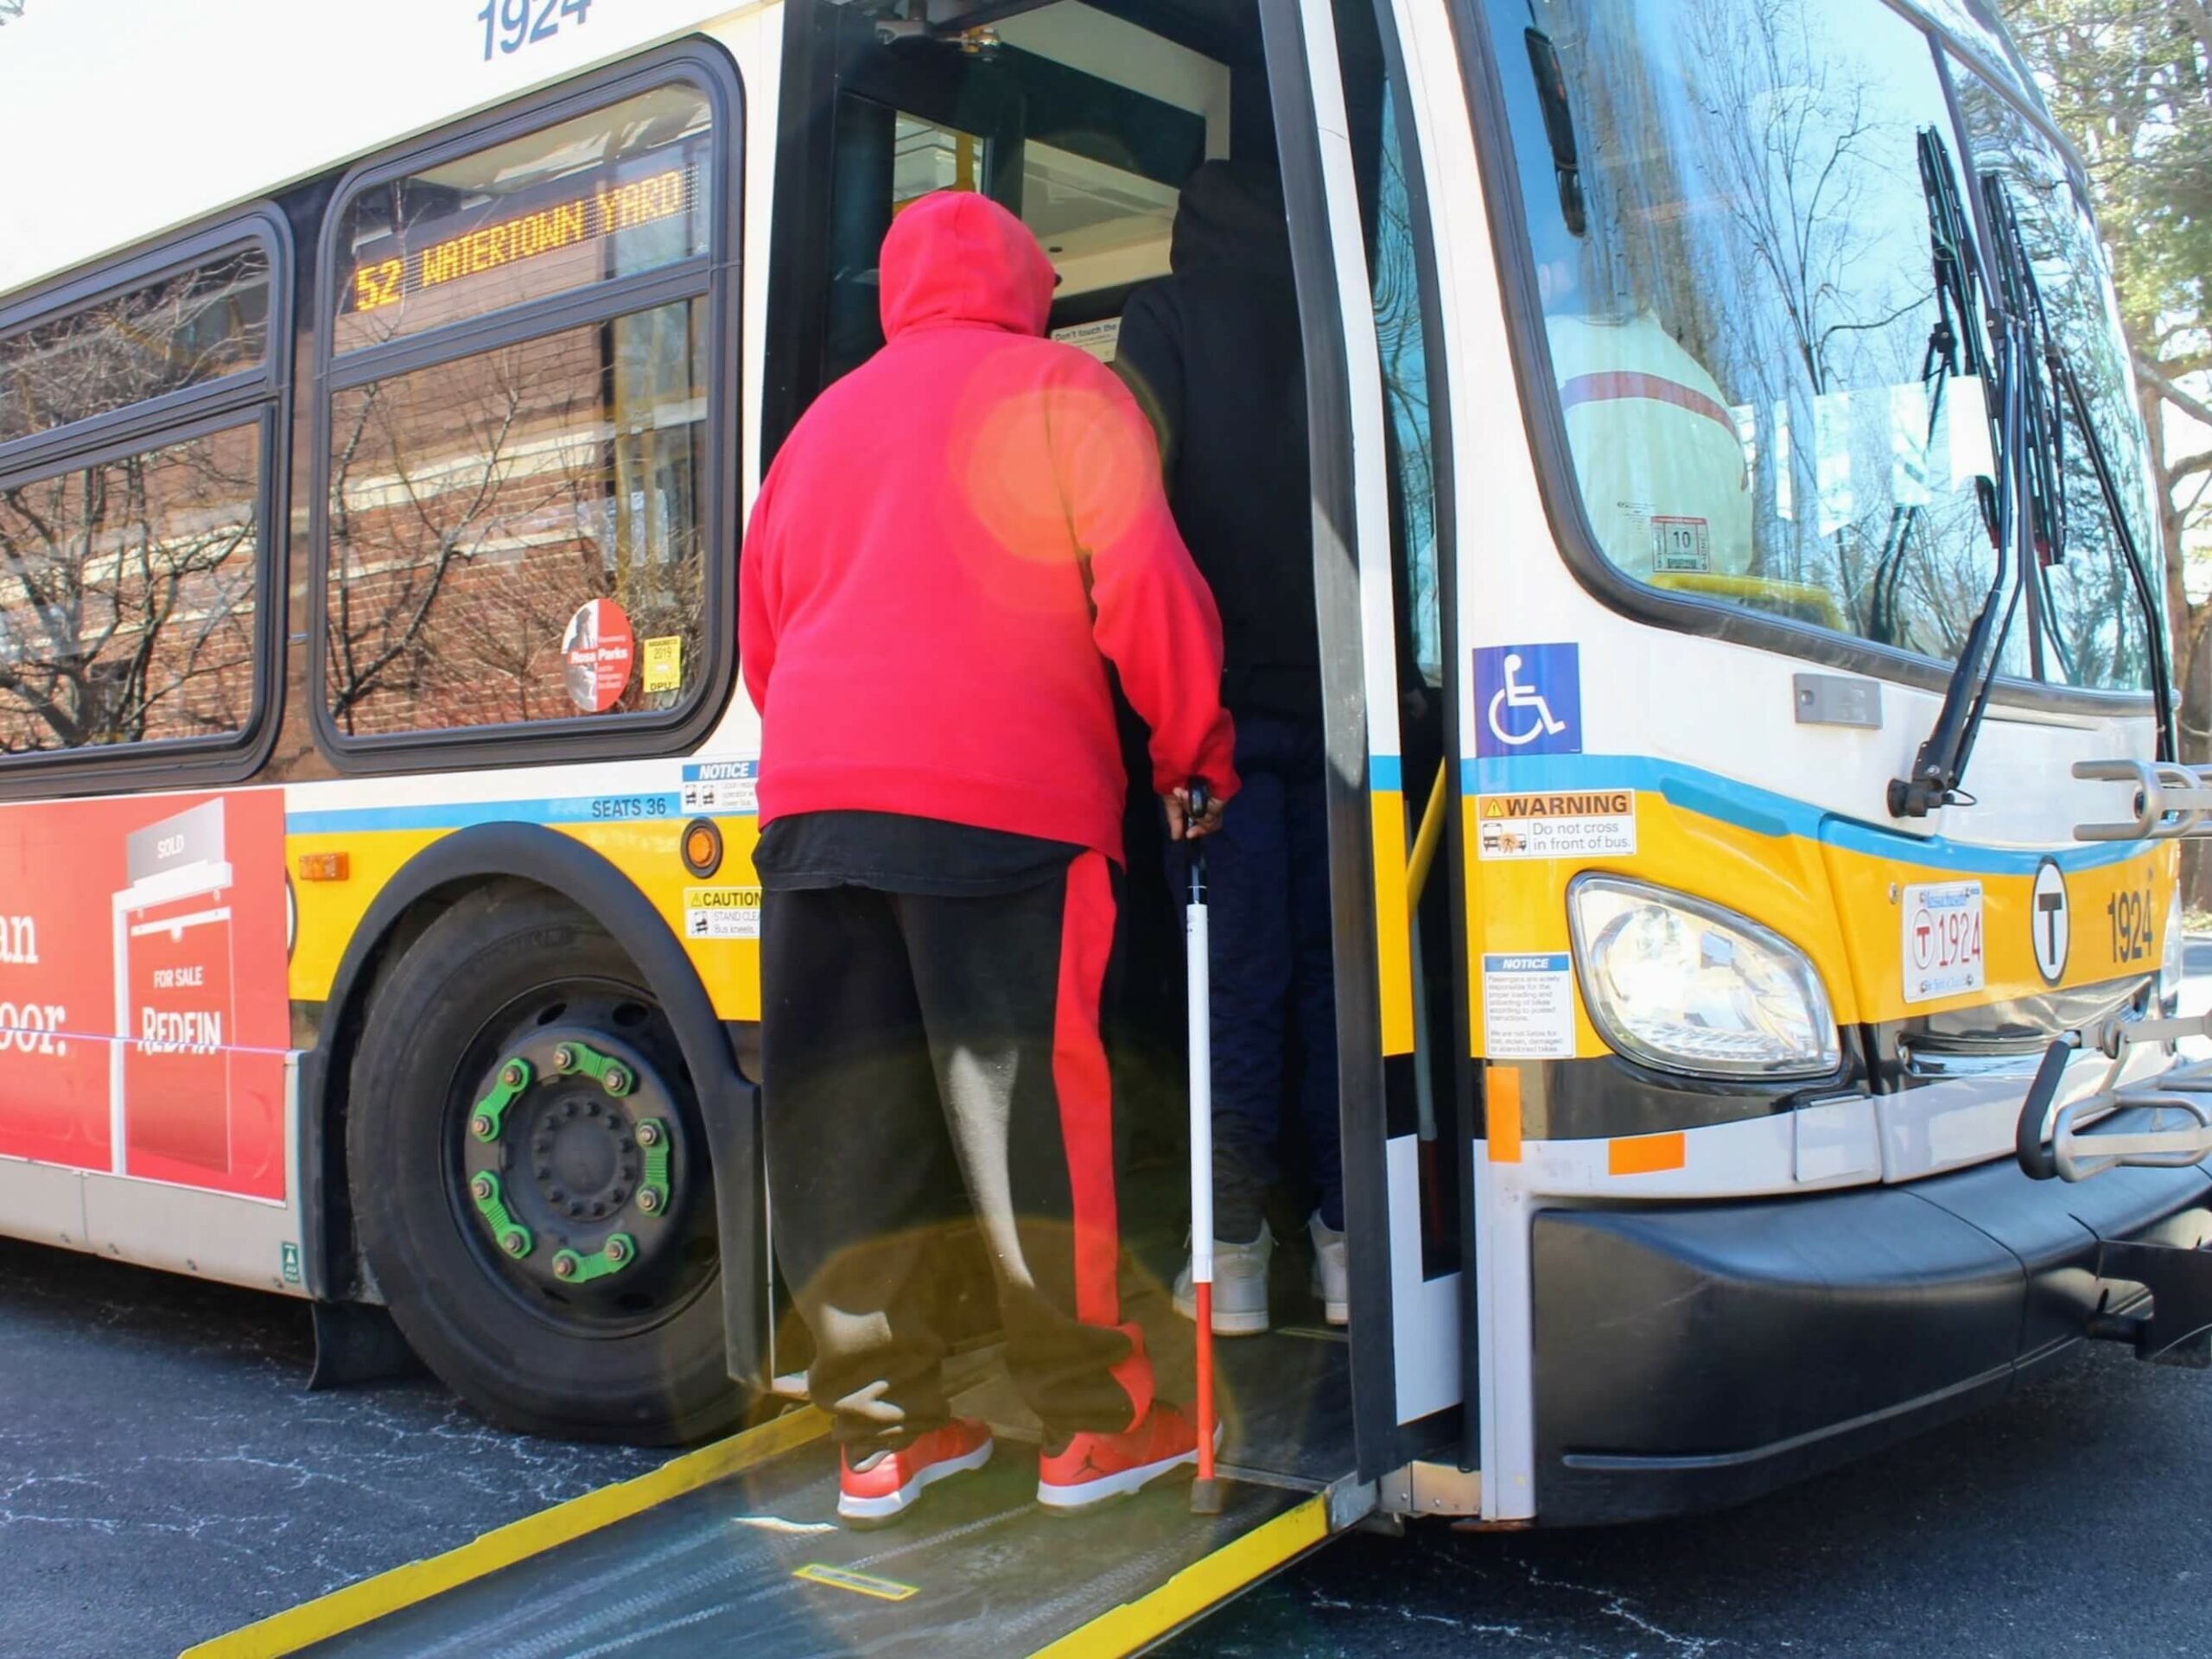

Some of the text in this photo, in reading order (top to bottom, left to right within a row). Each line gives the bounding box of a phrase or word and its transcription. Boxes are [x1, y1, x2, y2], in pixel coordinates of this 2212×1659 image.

[355, 170, 684, 311] 52 WATERTOWN YARD
[1672, 531, 1692, 550] 10
[570, 647, 628, 664] Rosa Parks
[653, 646, 672, 660] 2019
[650, 682, 672, 691] DPU
[699, 762, 750, 779] NOTICE
[592, 798, 666, 818] SEATS 36
[1506, 794, 1628, 817] WARNING
[1533, 822, 1619, 836] Do not cross
[157, 834, 185, 859] SOLD
[1534, 836, 1630, 851] in front of bus.
[702, 892, 760, 906] CAUTION
[714, 911, 741, 922] STAND
[2107, 889, 2152, 963] 1924
[2038, 893, 2063, 965] T
[1916, 911, 1980, 967] T 1924
[1503, 957, 1549, 969] NOTICE
[153, 965, 203, 989] FOR SALE
[137, 1006, 222, 1056] REDFIN
